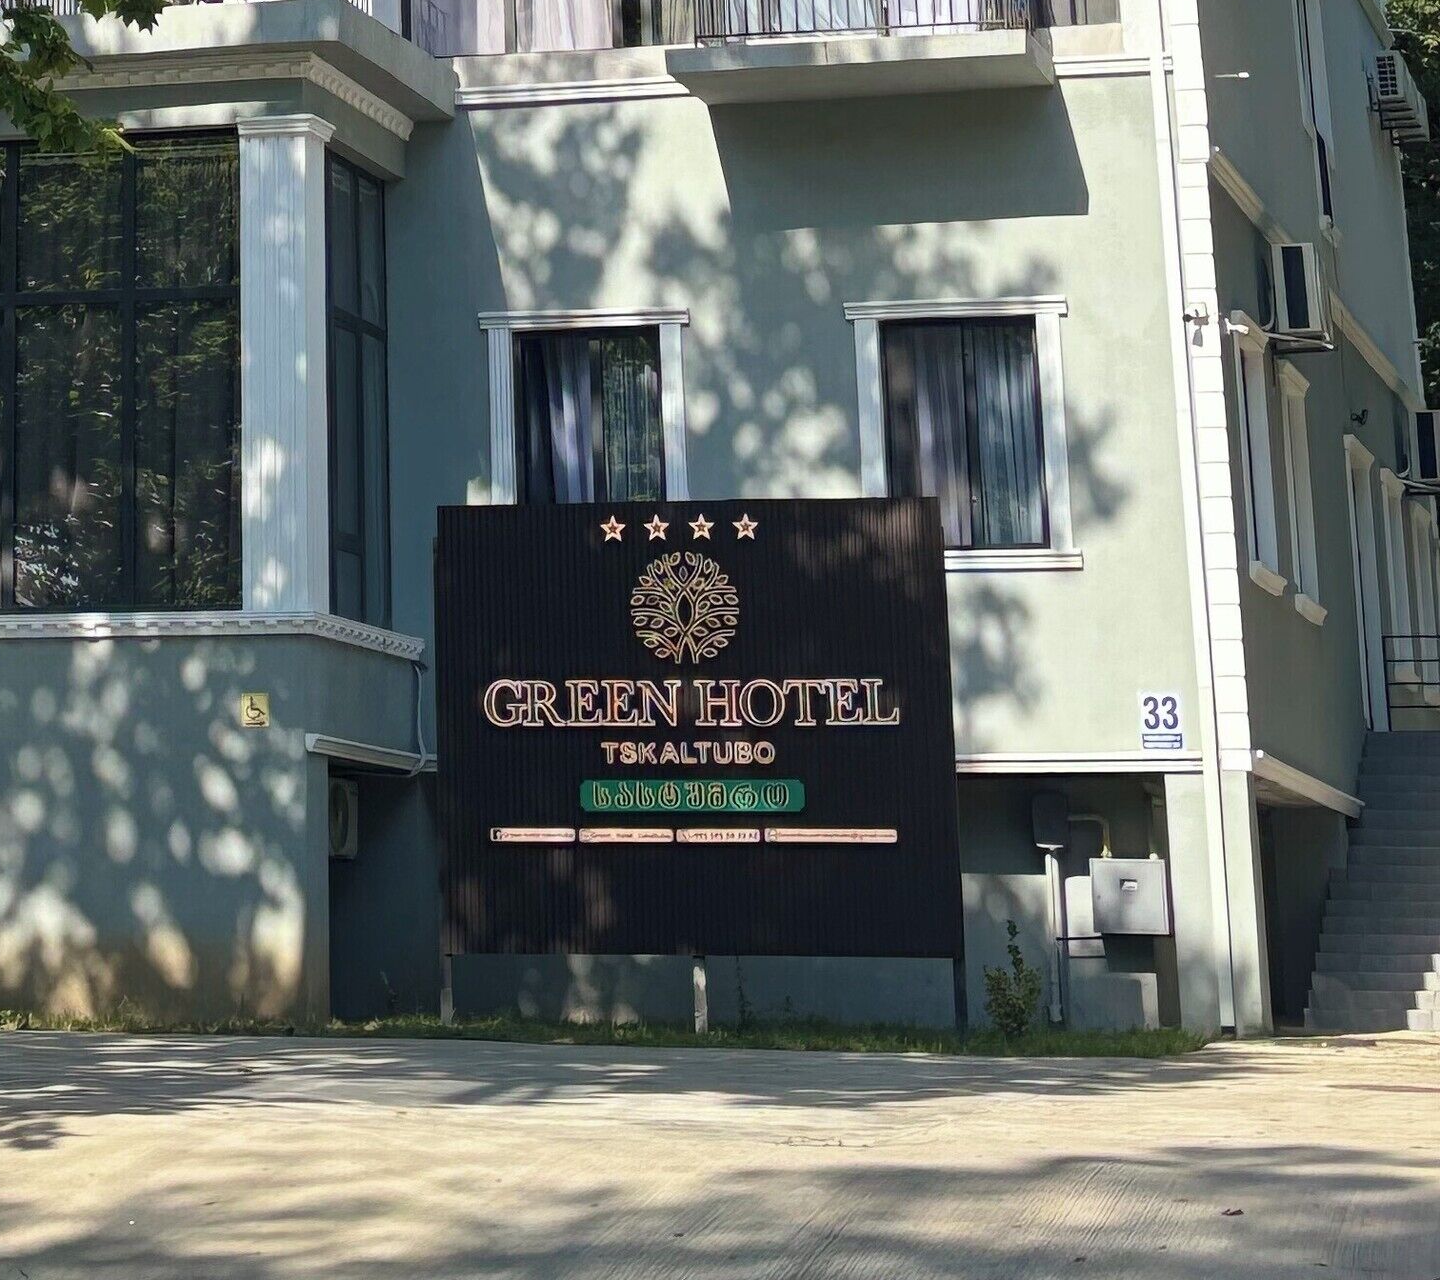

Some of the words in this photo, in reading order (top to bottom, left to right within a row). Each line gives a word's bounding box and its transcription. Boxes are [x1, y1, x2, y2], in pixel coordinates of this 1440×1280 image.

[483, 679, 681, 727] GREEN
[694, 678, 900, 727] HOTEL
[1143, 696, 1179, 730] 33
[601, 741, 776, 765] TSKALTUBO
